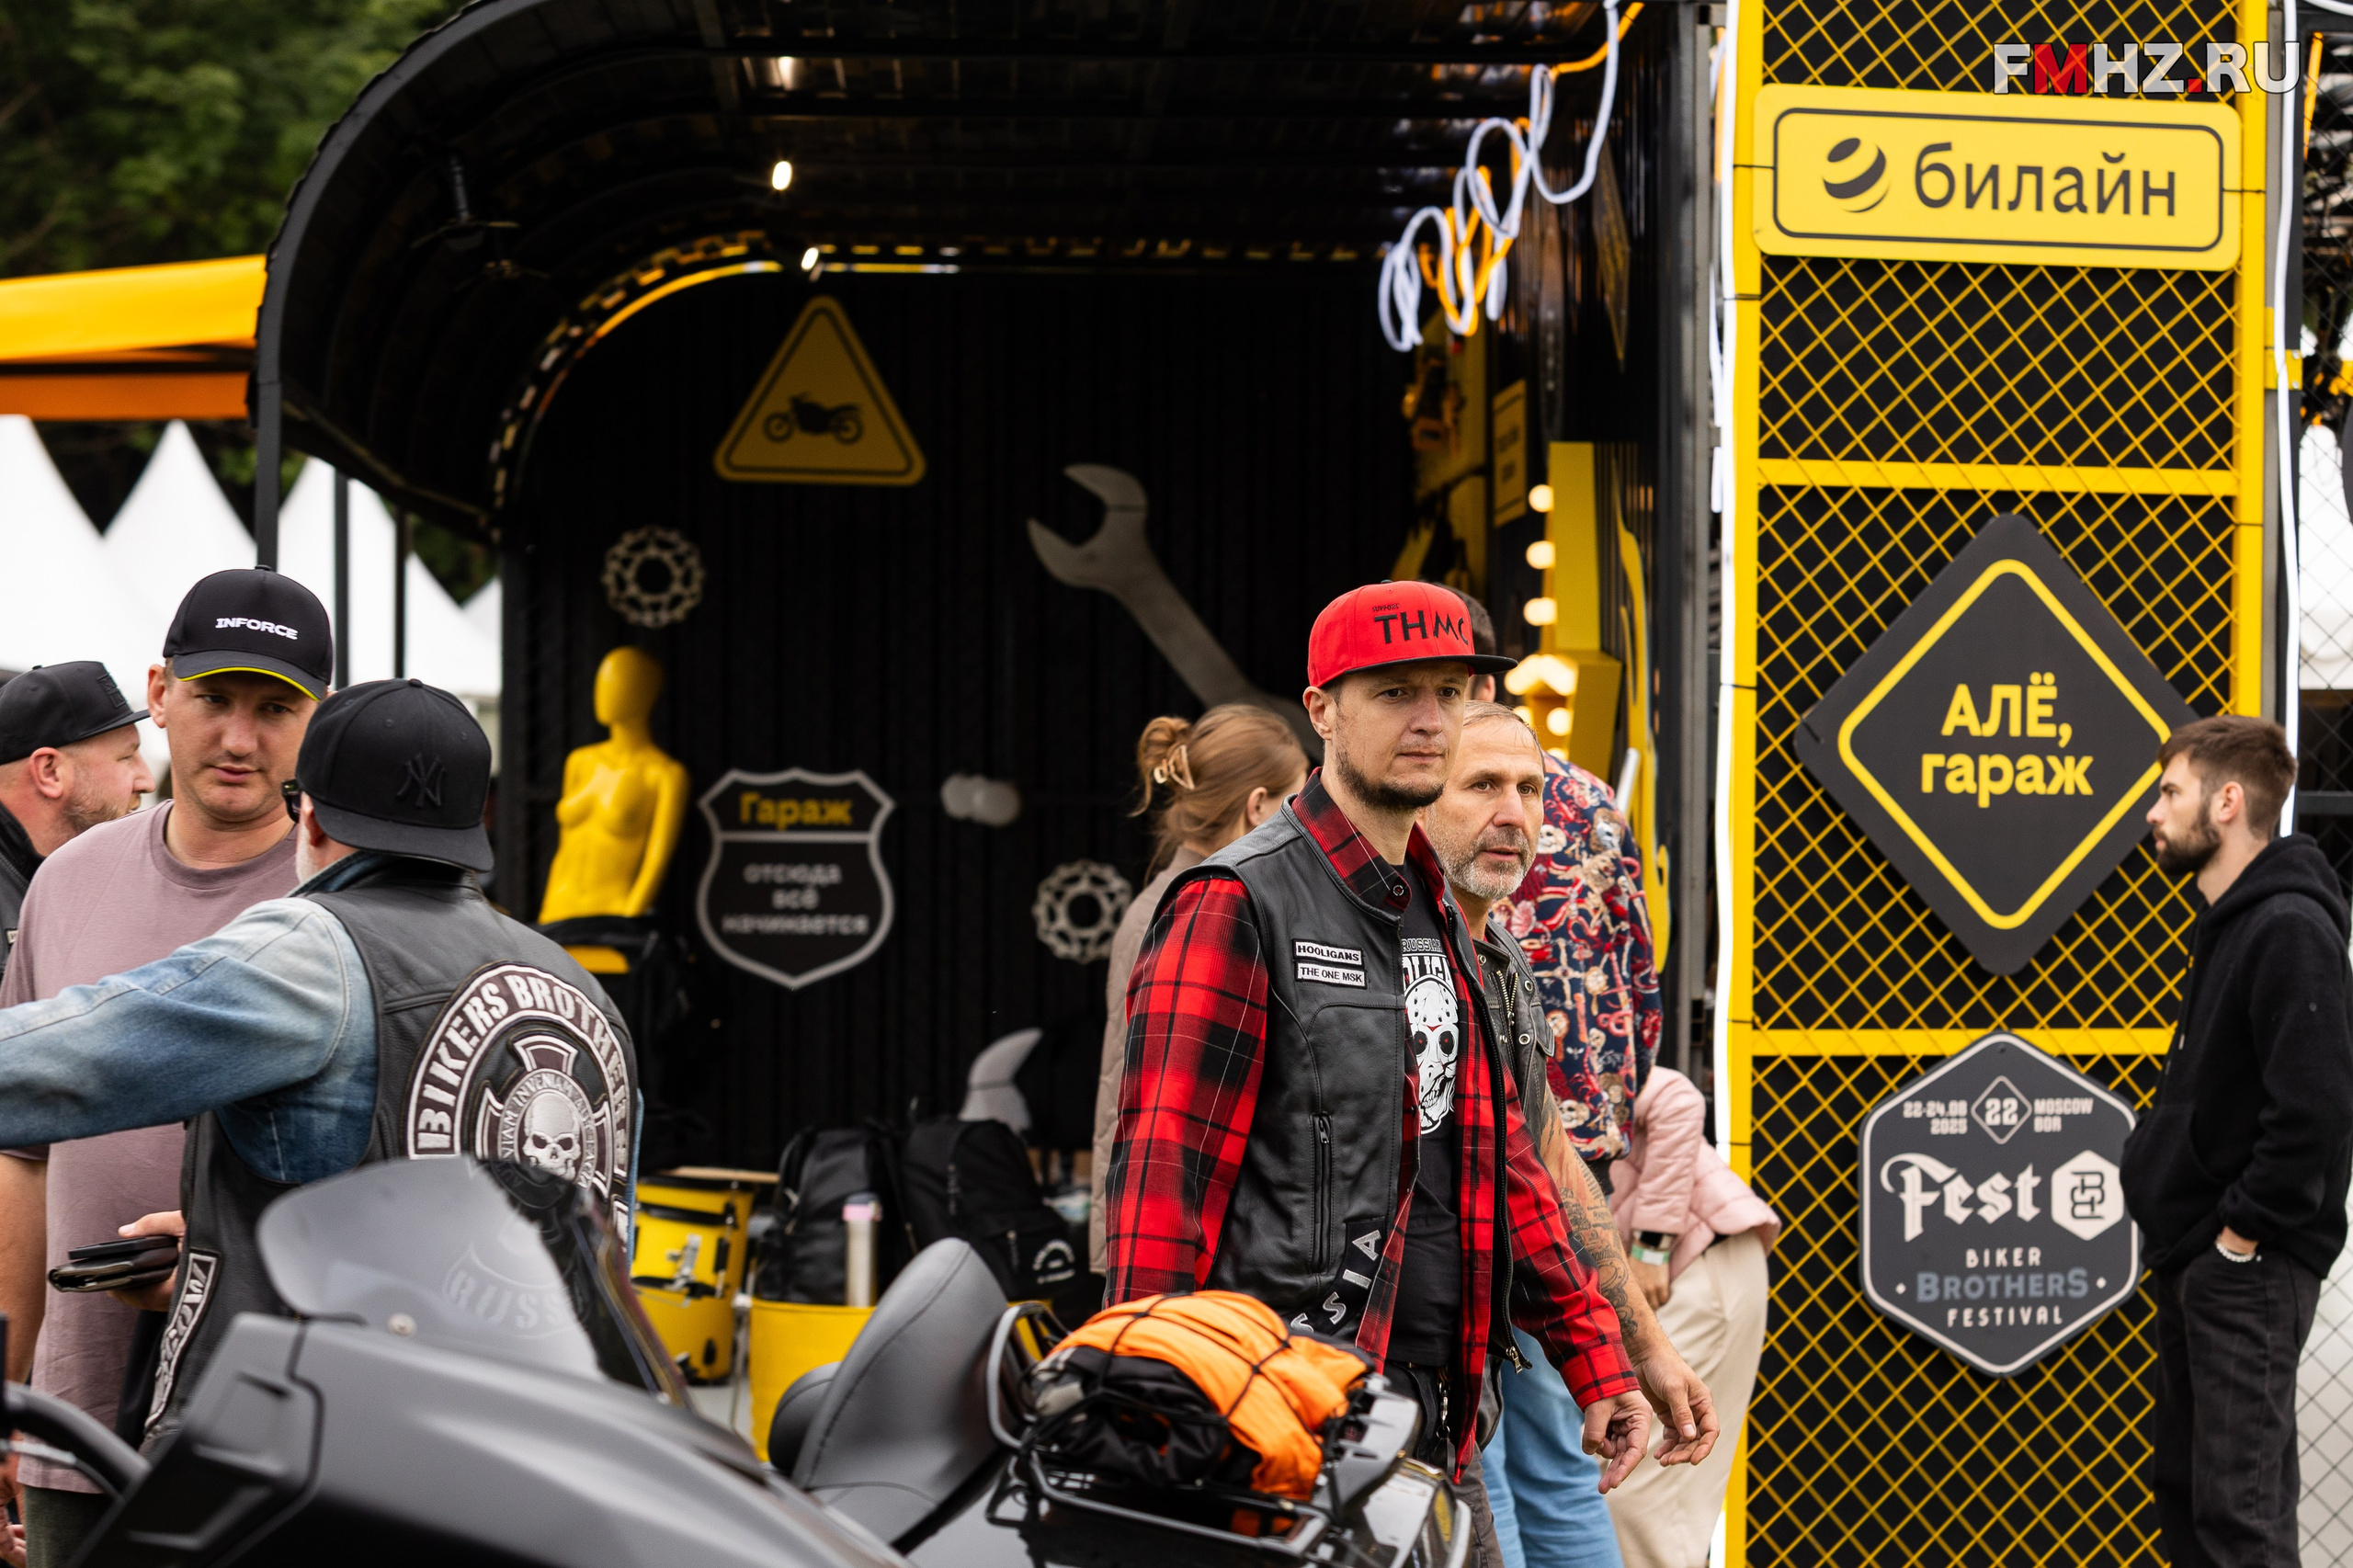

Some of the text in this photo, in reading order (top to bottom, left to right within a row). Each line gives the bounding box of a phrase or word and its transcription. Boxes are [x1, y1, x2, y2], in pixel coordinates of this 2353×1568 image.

[1915, 142, 2176, 217] билайн
[216, 618, 298, 640] INFORCE
[1941, 672, 2073, 748] АЛЁ,
[1921, 754, 2094, 808] гараж
[739, 791, 853, 830] Гараж
[1297, 945, 1359, 961] HOOLIGANS
[1301, 967, 1363, 983] THE ONE MSK
[417, 983, 508, 1149] BIKERS
[1984, 1097, 2018, 1126] 22
[2034, 1097, 2094, 1115] MOSCOW
[1930, 1118, 1968, 1135] 2025
[1880, 1153, 2041, 1242] Fest
[1965, 1247, 2042, 1268] BIKER
[1290, 1230, 1381, 1333] SSIA
[1915, 1267, 2089, 1303] BROTHERS
[1947, 1306, 2063, 1328] FESTIVAL
